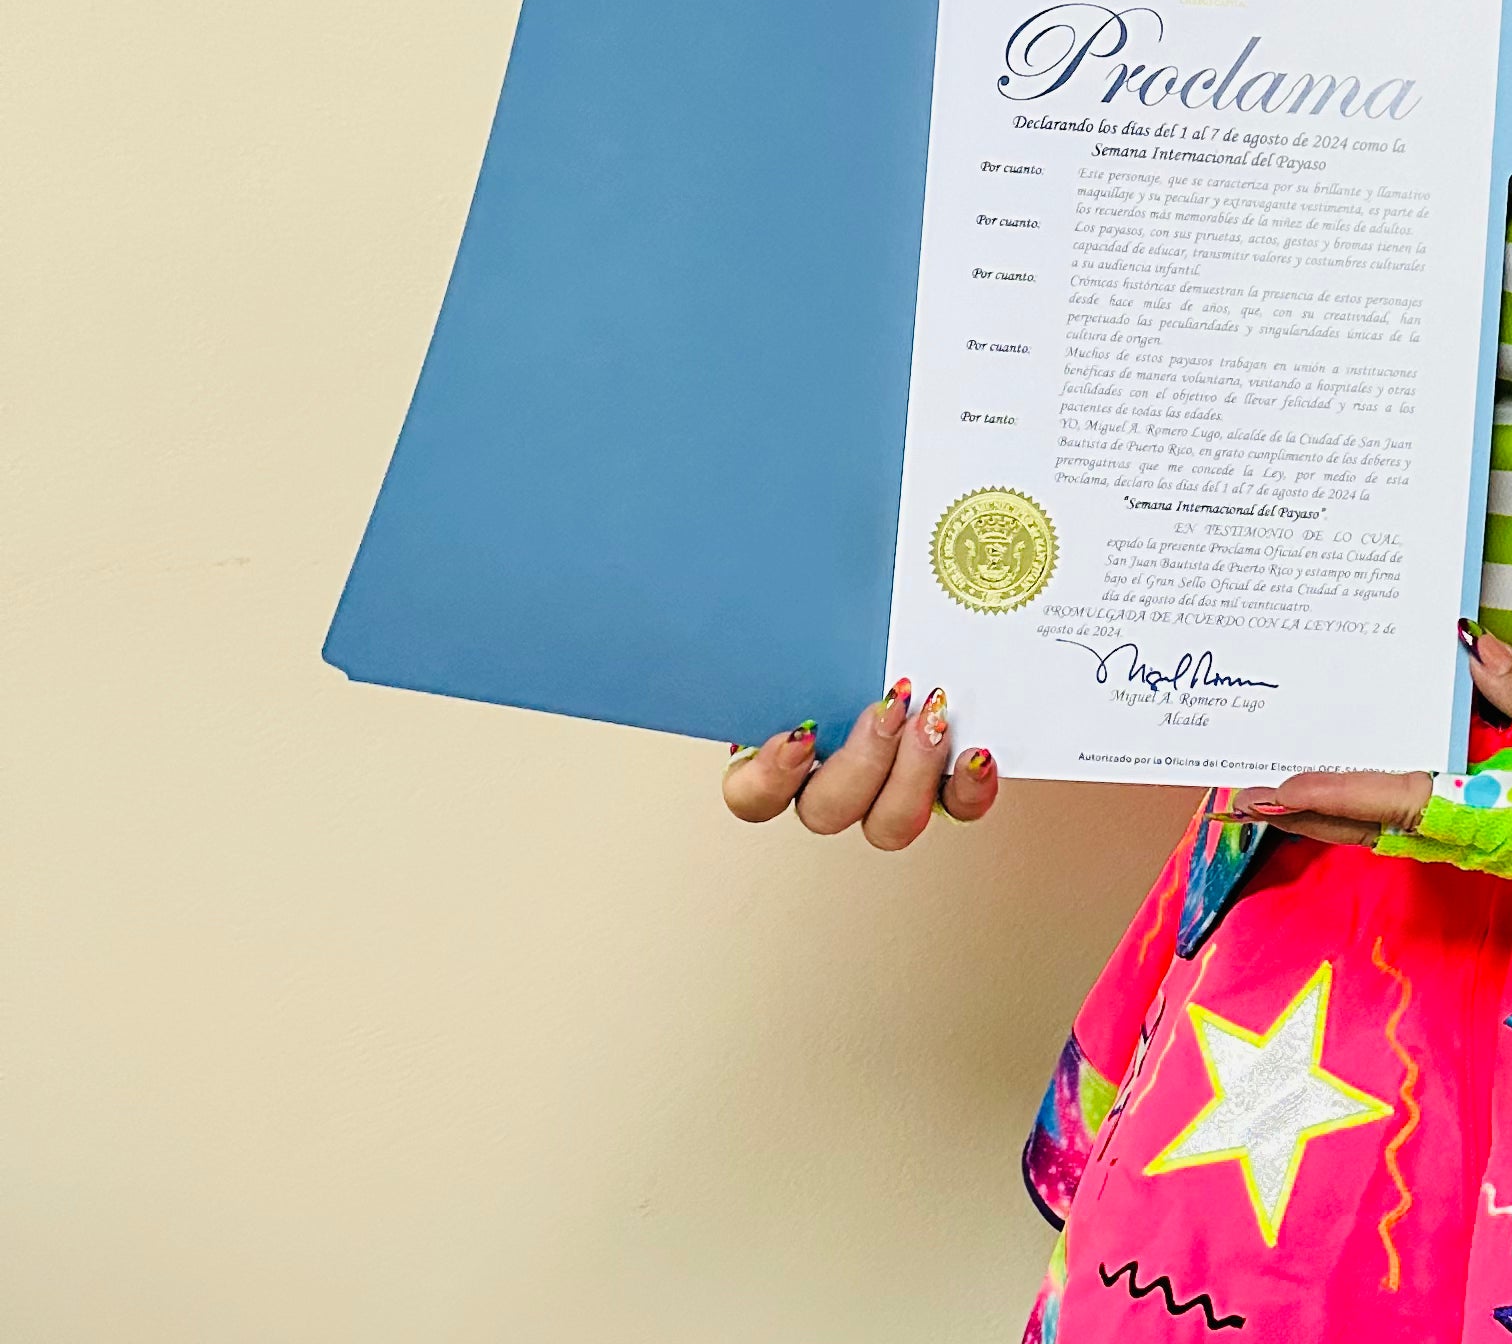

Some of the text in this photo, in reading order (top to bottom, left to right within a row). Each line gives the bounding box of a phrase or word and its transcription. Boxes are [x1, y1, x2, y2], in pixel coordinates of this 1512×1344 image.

[997, 3, 1423, 120] Proclama
[1013, 116, 1094, 132] Declarando
[1098, 120, 1118, 135] los
[1121, 122, 1151, 137] días
[1154, 124, 1178, 138] del
[1180, 126, 1188, 140] 1
[1192, 127, 1210, 141] al
[1211, 128, 1220, 141] 7
[1222, 128, 1239, 143] de
[1242, 134, 1289, 149] agosto
[1292, 133, 1309, 147] de
[1312, 135, 1348, 150] 2024
[1352, 141, 1388, 152] como
[980, 161, 1002, 172] Por
[1091, 144, 1327, 174] Semana Internacional del Payaso
[1078, 168, 1104, 180] Este
[1168, 176, 1189, 189] que
[1272, 184, 1294, 196] por
[1076, 202, 1092, 215] los
[1322, 218, 1351, 232] miles
[1164, 192, 1211, 206] peculiar
[1382, 208, 1414, 221] parte
[976, 214, 998, 226] Por
[1074, 221, 1096, 233] Los
[1150, 229, 1170, 239] con
[1173, 230, 1192, 240] sus
[1334, 236, 1374, 252] bromas
[1252, 251, 1293, 264] valores
[972, 268, 994, 279] Por
[1068, 292, 1422, 326] desde hace miles con han
[1334, 294, 1363, 304] estos
[1136, 314, 1154, 327] las
[966, 339, 988, 351] Por
[1066, 328, 1107, 342] cultura
[1066, 346, 1111, 360] Muchos
[1136, 354, 1164, 364] estos
[1168, 356, 1214, 369] payasos
[1220, 356, 1267, 373] trabajan
[1136, 372, 1178, 382] manera
[1388, 386, 1416, 396] otras
[1130, 390, 1149, 398] con
[1172, 388, 1218, 405] objetivo
[1399, 401, 1416, 414] los
[1132, 404, 1163, 417] todas
[1165, 405, 1182, 419] las
[960, 411, 982, 422] Por
[1086, 420, 1128, 435] Miguel
[1146, 424, 1188, 437] Romero
[1226, 428, 1267, 442] alcalde
[1299, 433, 1344, 446] Ciudad
[1358, 437, 1380, 449] San
[1382, 438, 1412, 451] Juan
[1058, 436, 1108, 450] Bautista
[1126, 441, 1164, 453] Puerto
[1213, 449, 1245, 461] grato
[1342, 452, 1358, 465] los
[1138, 462, 1160, 474] que
[1192, 464, 1235, 476] concede
[1294, 472, 1316, 484] por
[1324, 470, 1357, 483] medio
[1386, 476, 1410, 485] esta
[1114, 474, 1154, 489] declaro
[1156, 477, 1173, 490] los
[1176, 479, 1199, 492] días
[1202, 480, 1222, 493] del
[1272, 488, 1309, 501] agosto
[1328, 488, 1357, 500] 2024
[1257, 504, 1278, 517] del
[1106, 537, 1391, 563] expido presente Proclama Oficial esta Ciudad
[1106, 554, 1400, 584] San Juan Bautista Puerto Rico estampo firma
[1104, 571, 1400, 601] bajo Gran Sello Oficial esta Ciudad segundo
[1139, 593, 1241, 608] agosto del dos mil
[1036, 625, 1074, 637] agosto
[1174, 613, 1245, 627] ACUERDO
[1248, 616, 1280, 628] CON
[1304, 620, 1336, 631] LEY
[1110, 689, 1265, 713] Miguel Romero Lugo
[1134, 757, 1152, 765] por
[1164, 756, 1200, 767] Oficina
[1202, 759, 1218, 768] del
